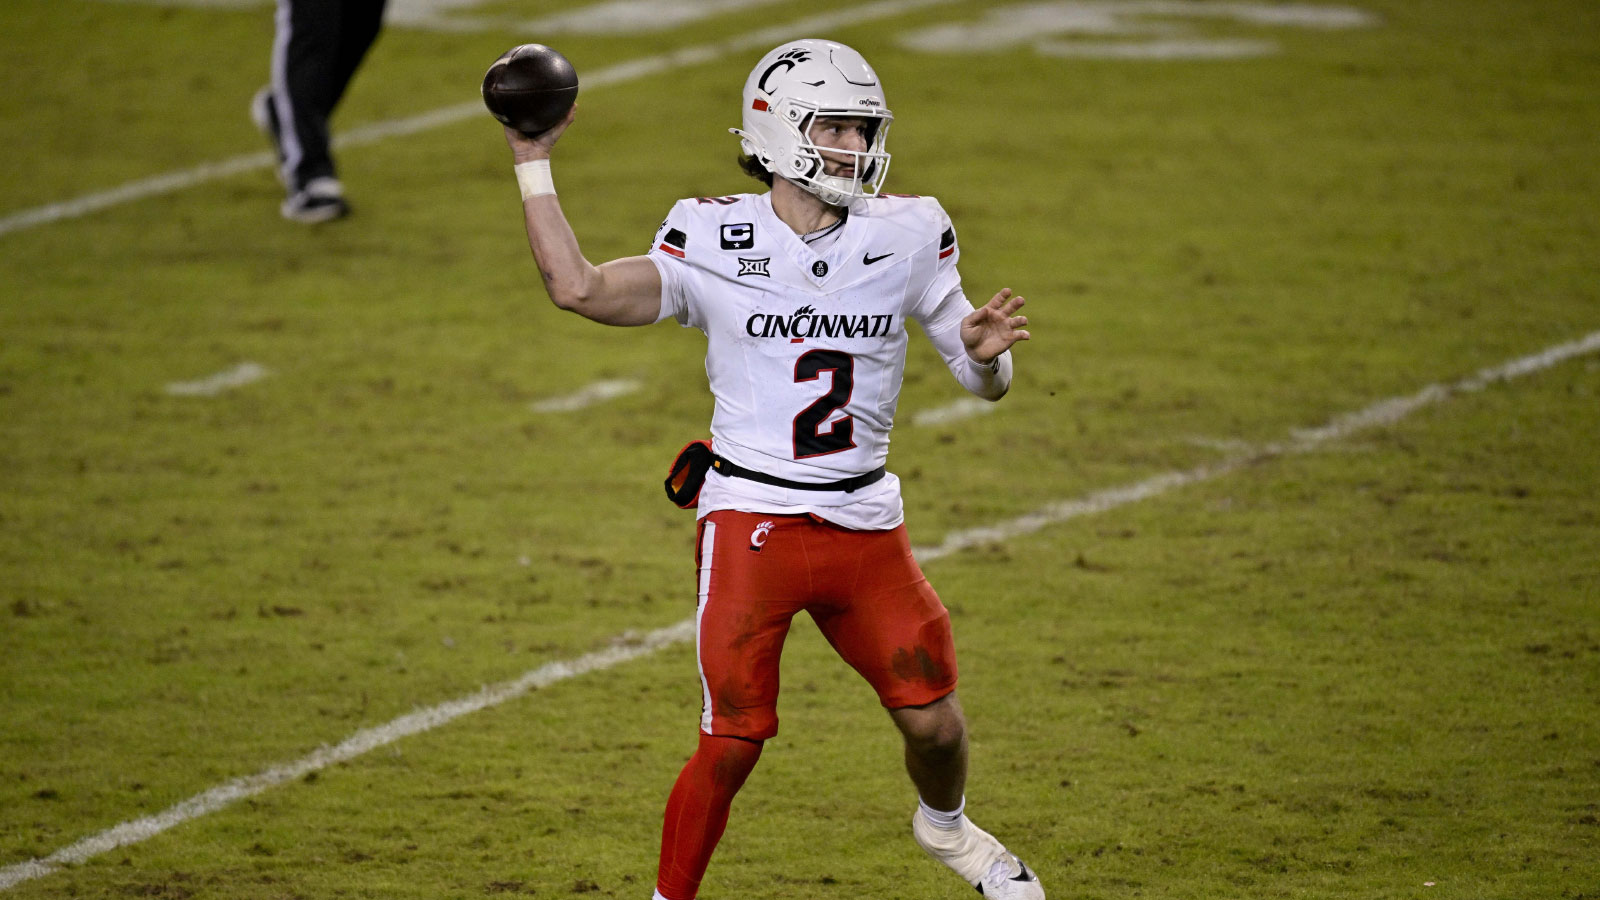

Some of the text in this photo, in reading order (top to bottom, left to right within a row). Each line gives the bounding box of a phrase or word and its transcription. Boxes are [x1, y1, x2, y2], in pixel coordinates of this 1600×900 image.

[723, 224, 751, 241] C
[738, 258, 770, 277] XII
[746, 313, 893, 338] CINCINNATI
[793, 349, 857, 460] 2
